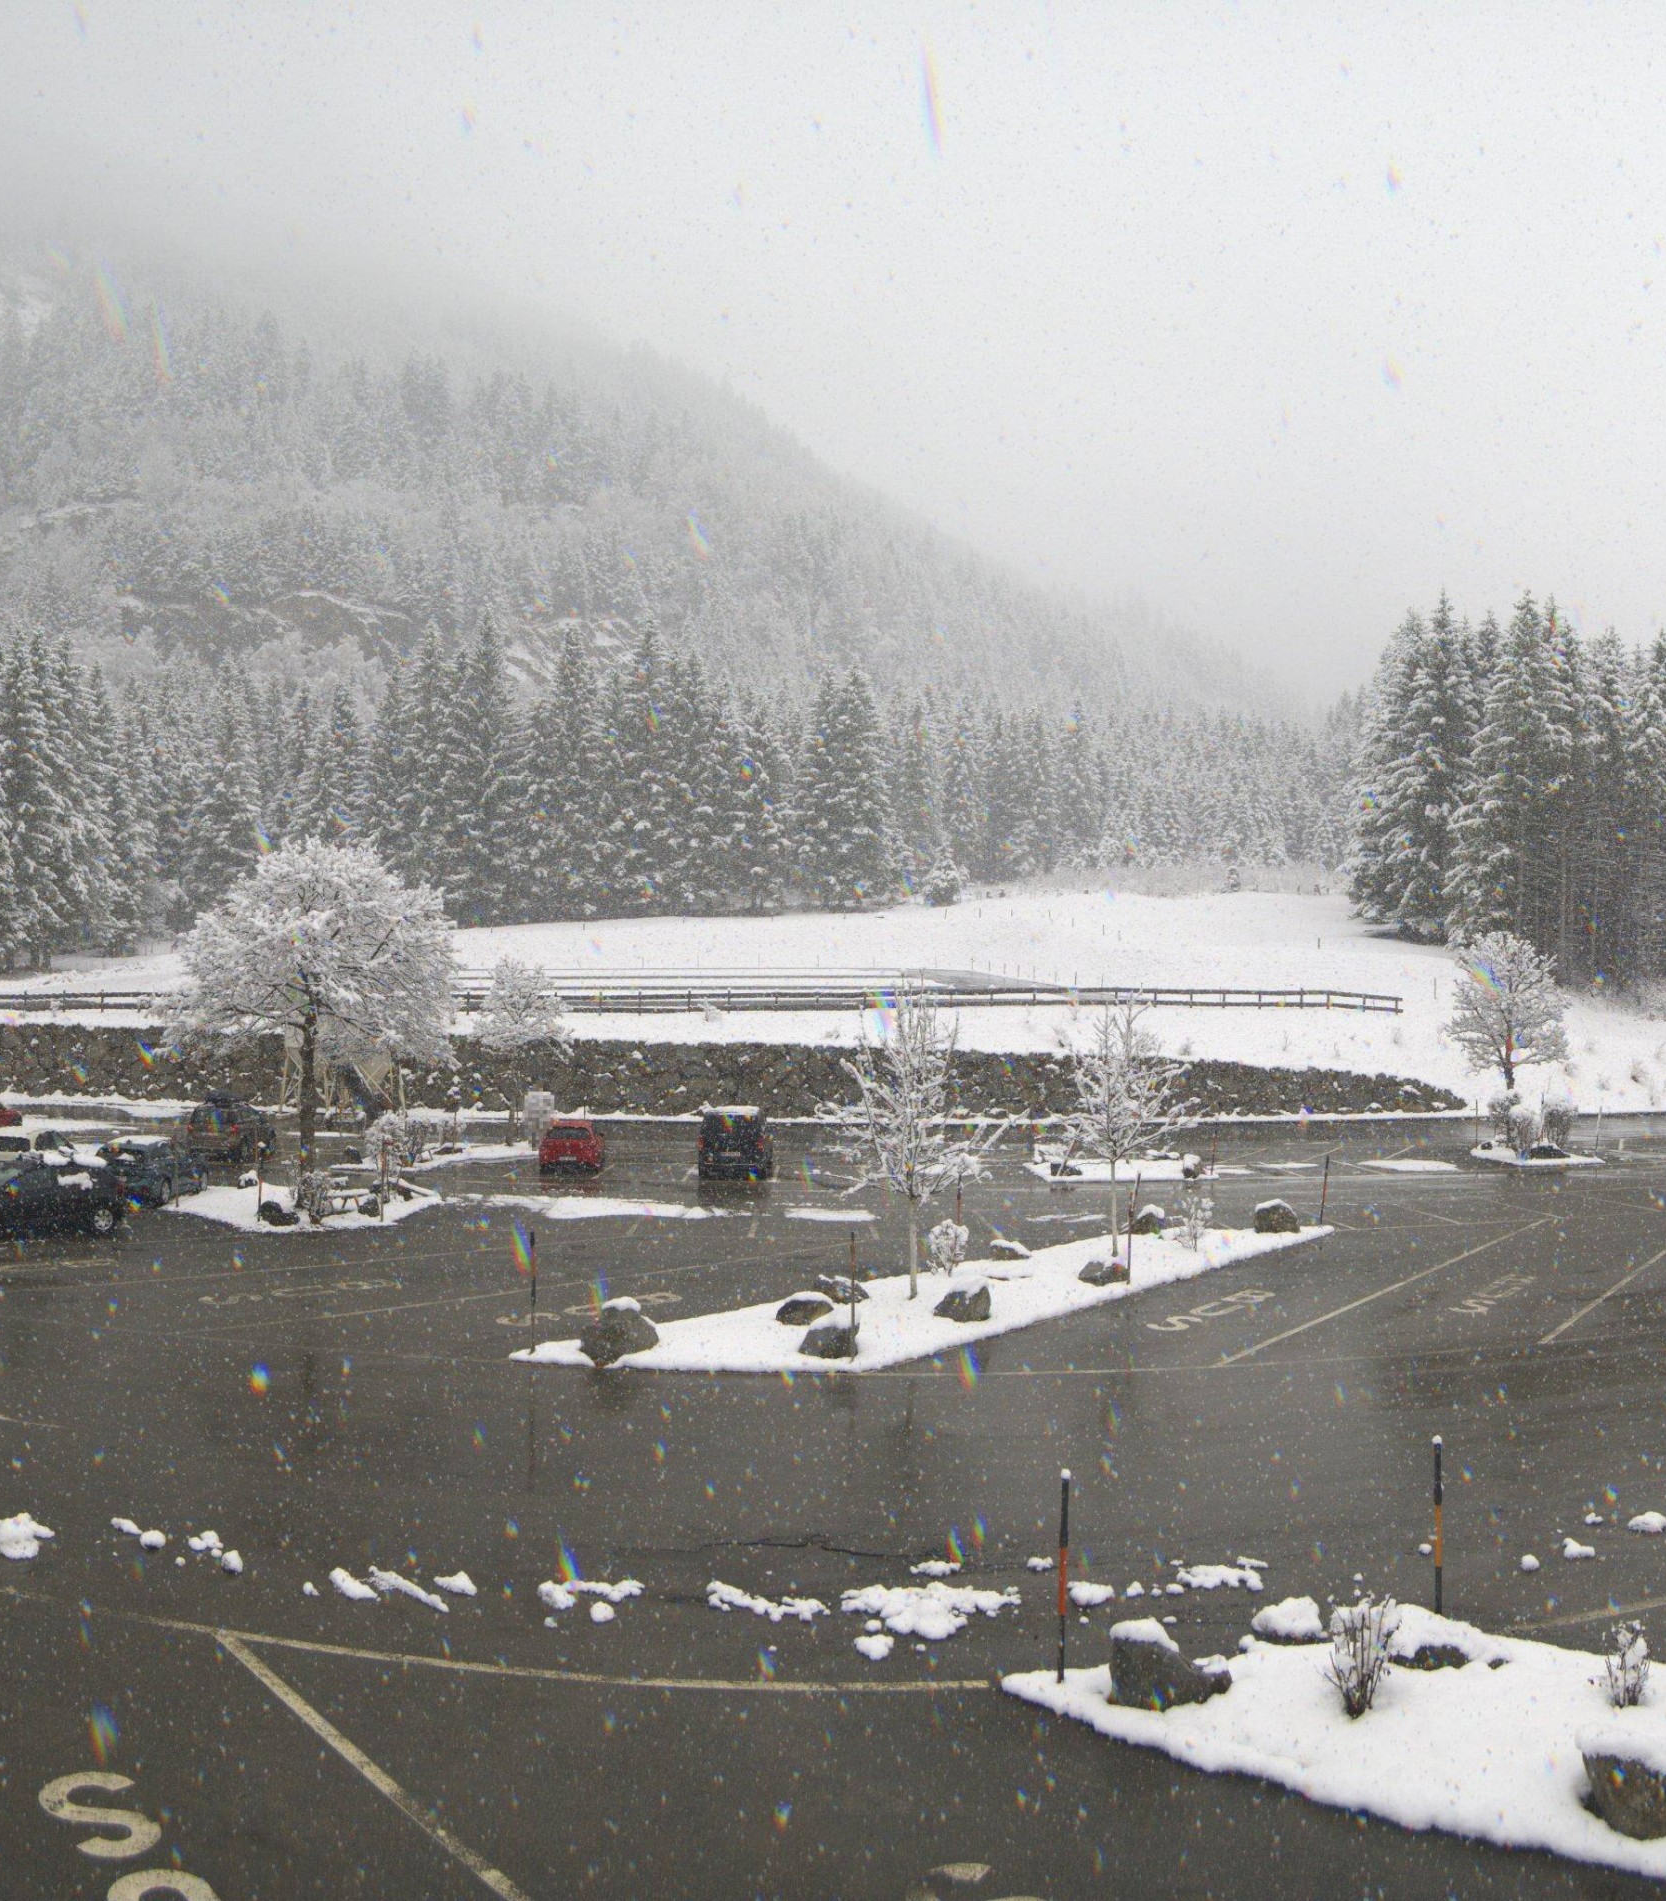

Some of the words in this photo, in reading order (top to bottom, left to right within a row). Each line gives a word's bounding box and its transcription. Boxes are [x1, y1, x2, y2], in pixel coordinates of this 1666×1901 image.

[199, 1278, 397, 1305] BUS
[1146, 1288, 1276, 1332] BUS
[1448, 1273, 1537, 1317] BUS
